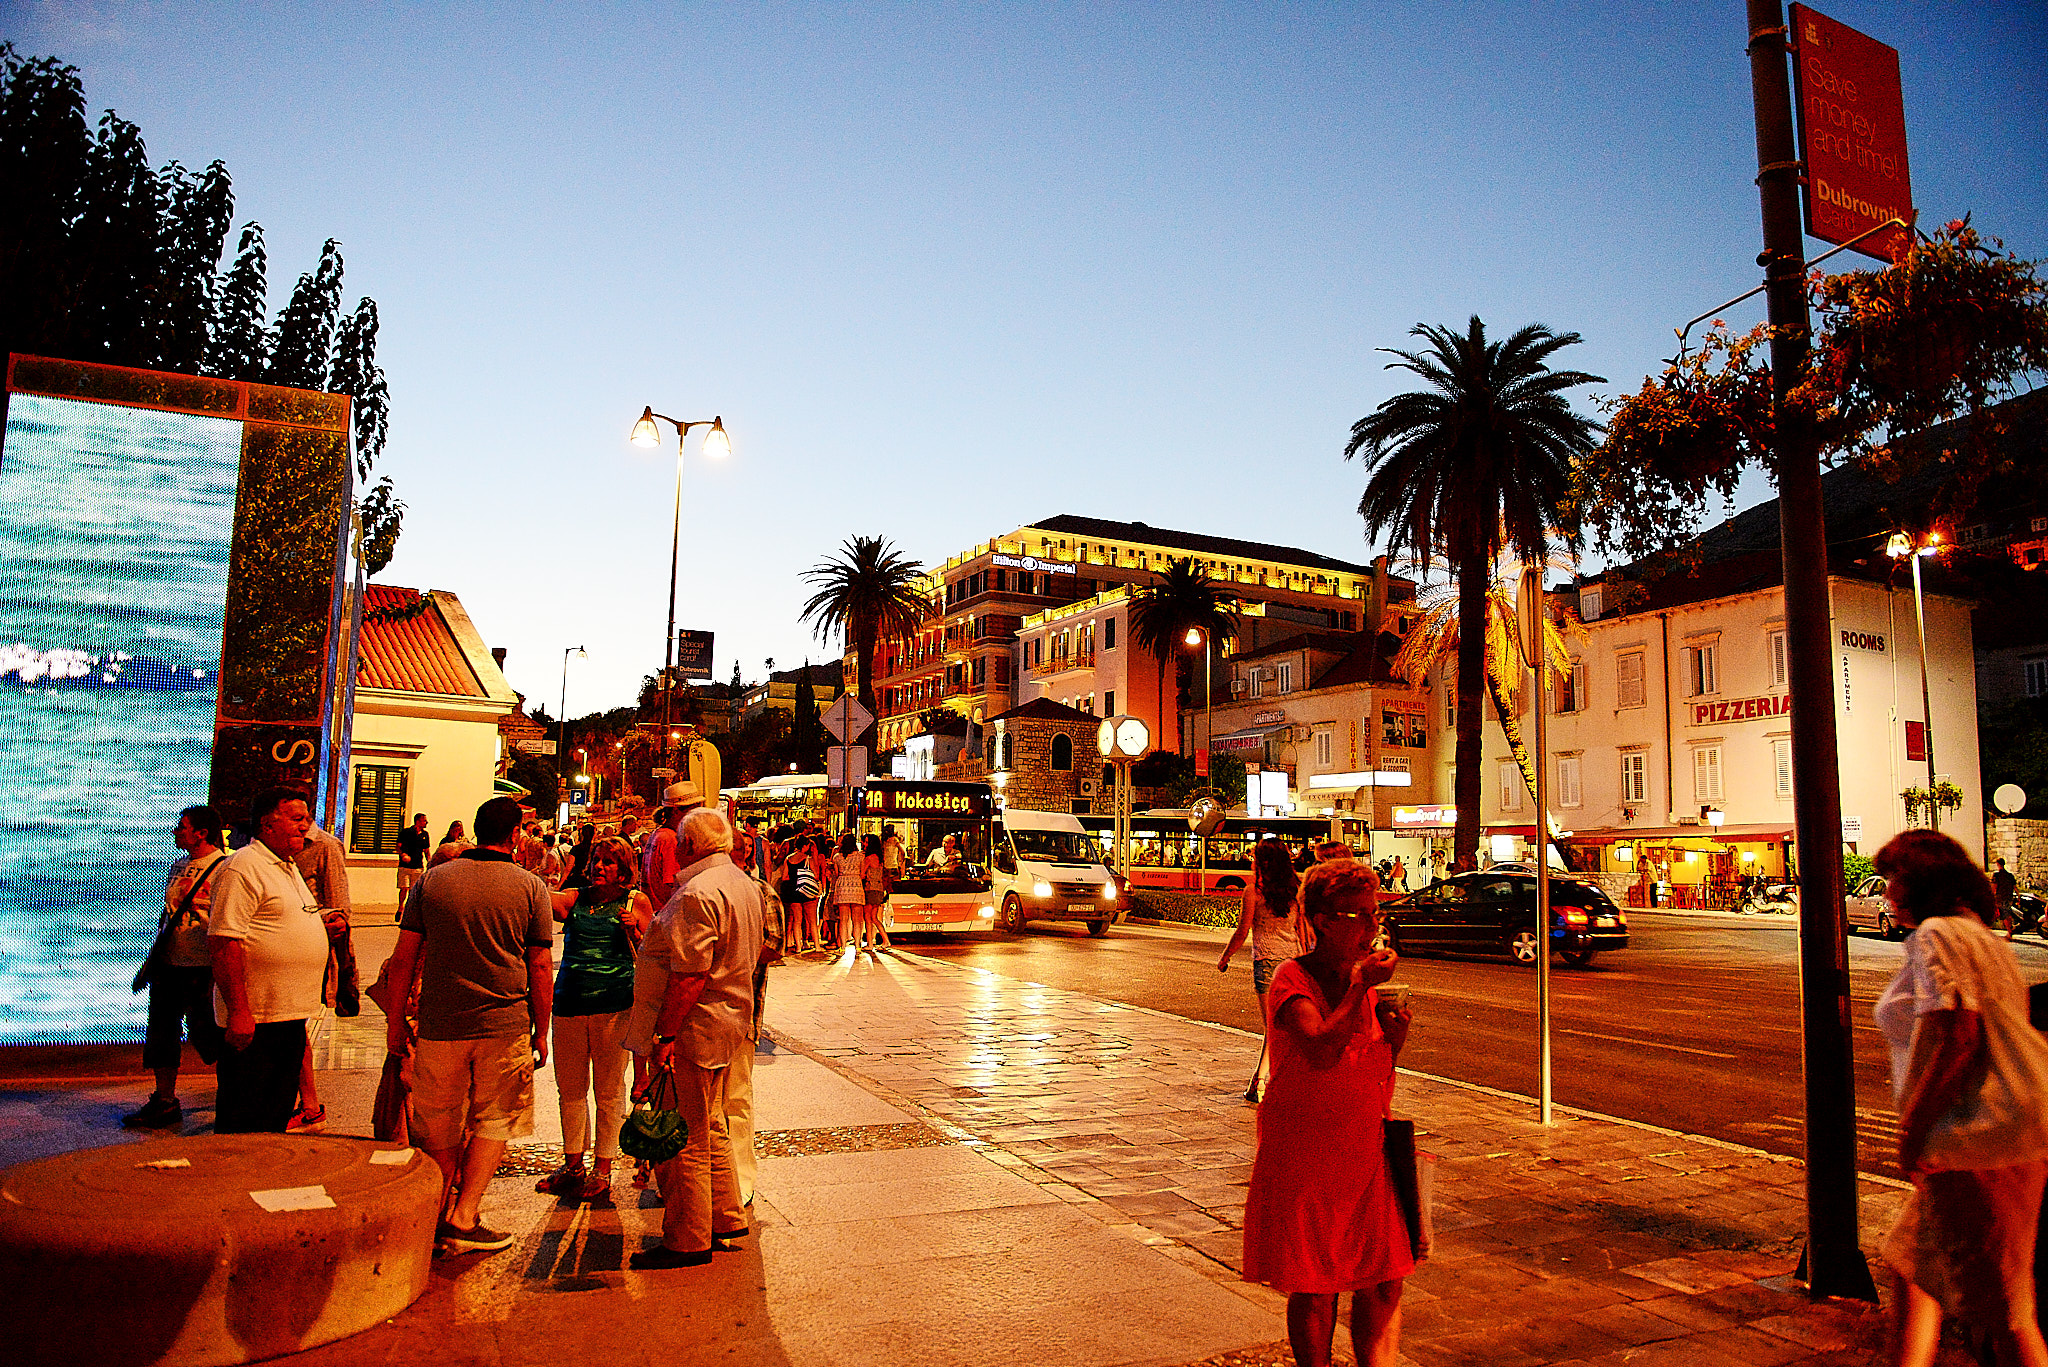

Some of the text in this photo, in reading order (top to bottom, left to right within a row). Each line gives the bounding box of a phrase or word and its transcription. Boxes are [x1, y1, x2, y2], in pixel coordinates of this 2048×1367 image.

[1808, 57, 1857, 101] Save
[1811, 96, 1876, 146] money
[1813, 128, 1899, 181] and time!
[1818, 201, 1855, 232] Card
[992, 554, 1076, 575] Hilton Imperial
[680, 639, 705, 649] Special
[1841, 630, 1885, 651] ROOMS
[1381, 698, 1426, 710] APARTMENTS
[1696, 695, 1790, 724] PIZZERIA
[1400, 757, 1408, 765] CAR
[573, 791, 582, 803] P
[866, 791, 883, 808] 1A
[1308, 792, 1346, 800] EXCHANGE
